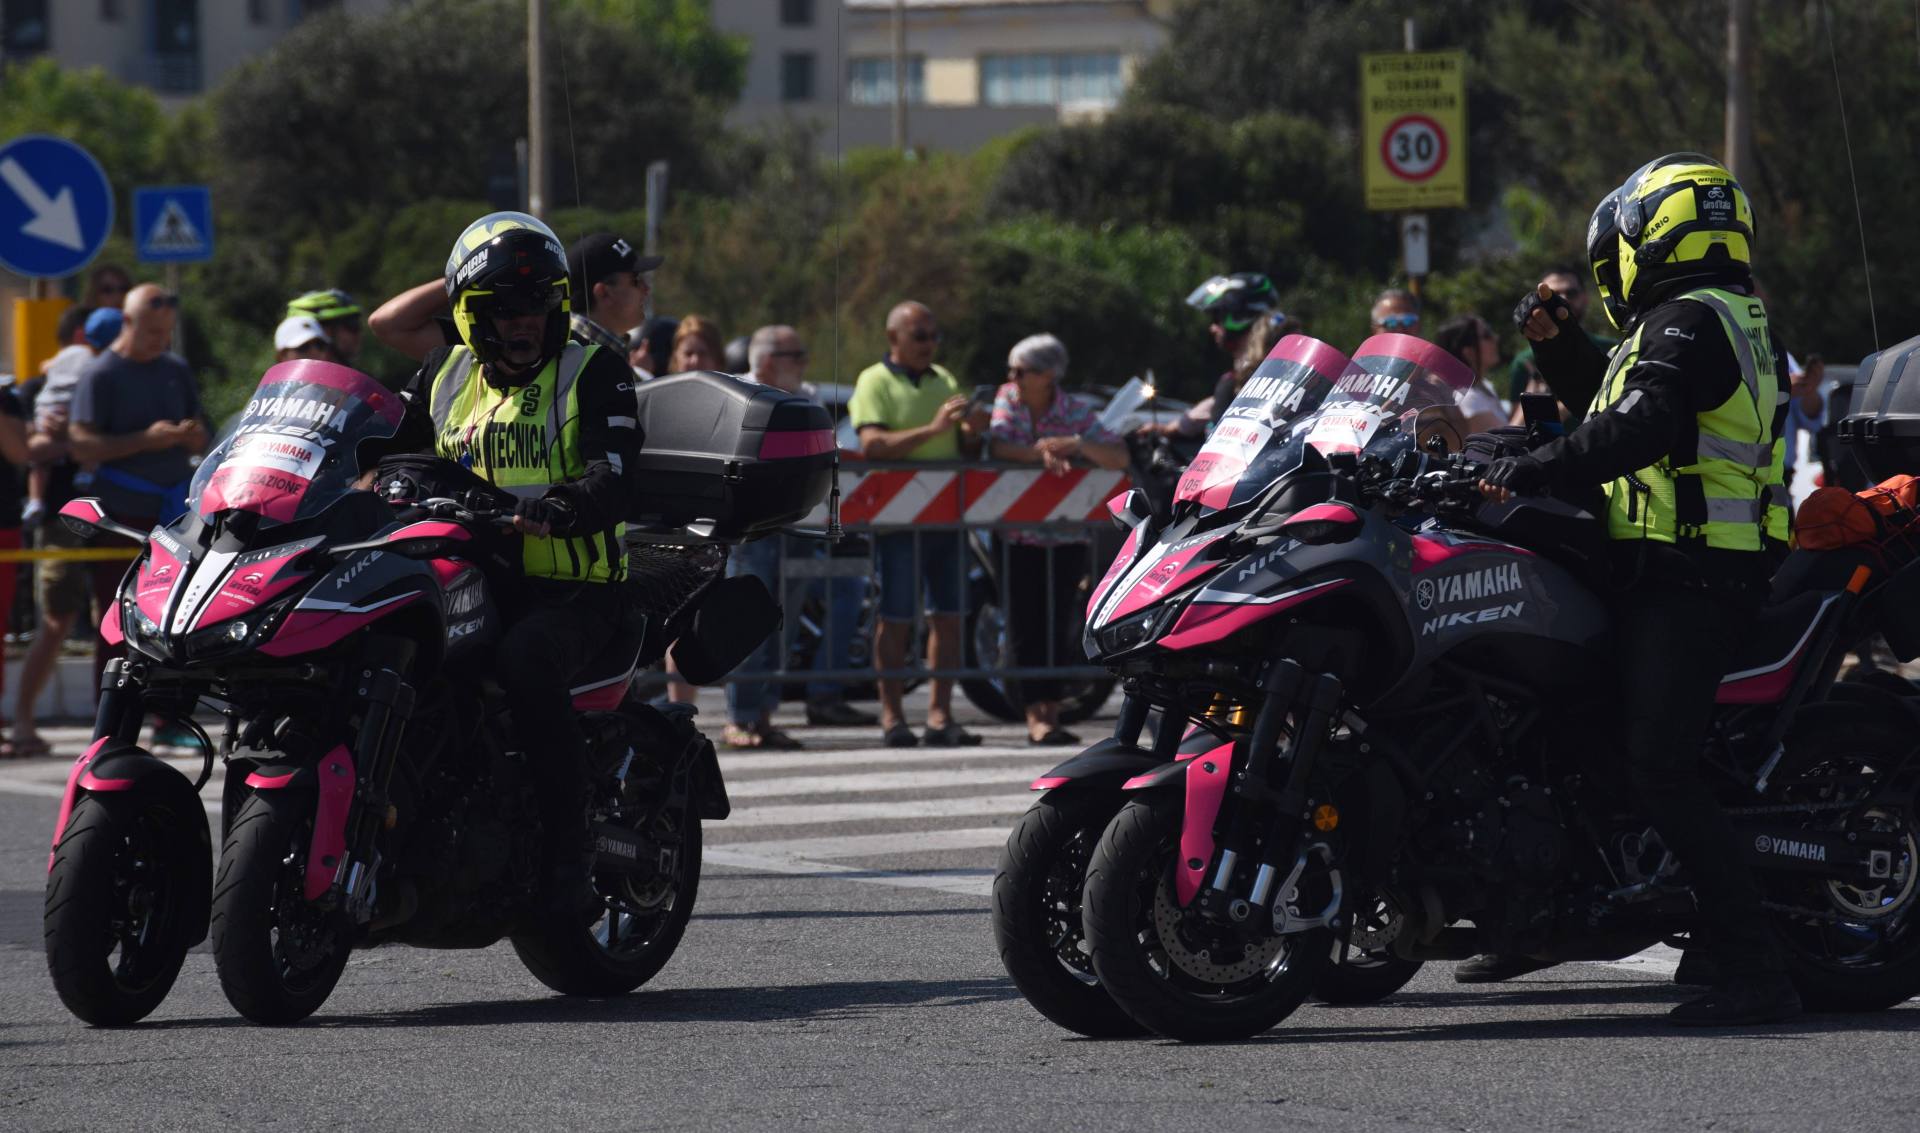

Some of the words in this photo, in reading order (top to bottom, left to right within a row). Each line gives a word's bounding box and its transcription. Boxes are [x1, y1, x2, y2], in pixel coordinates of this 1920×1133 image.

[1396, 131, 1433, 162] 30
[1644, 215, 1670, 239] MARIO
[457, 248, 488, 285] NOLAN
[257, 397, 349, 434] YAMAHA
[267, 442, 313, 463] YAMAHA
[489, 422, 550, 469] TECNICA
[336, 550, 383, 590] NIKE
[1239, 538, 1302, 583] NIKE
[1437, 561, 1523, 603] YAMAHA
[448, 616, 485, 639] KEN
[1422, 601, 1525, 637] NIKEN
[607, 838, 637, 860] YAMAHA
[1772, 838, 1826, 861] YAMAHA
